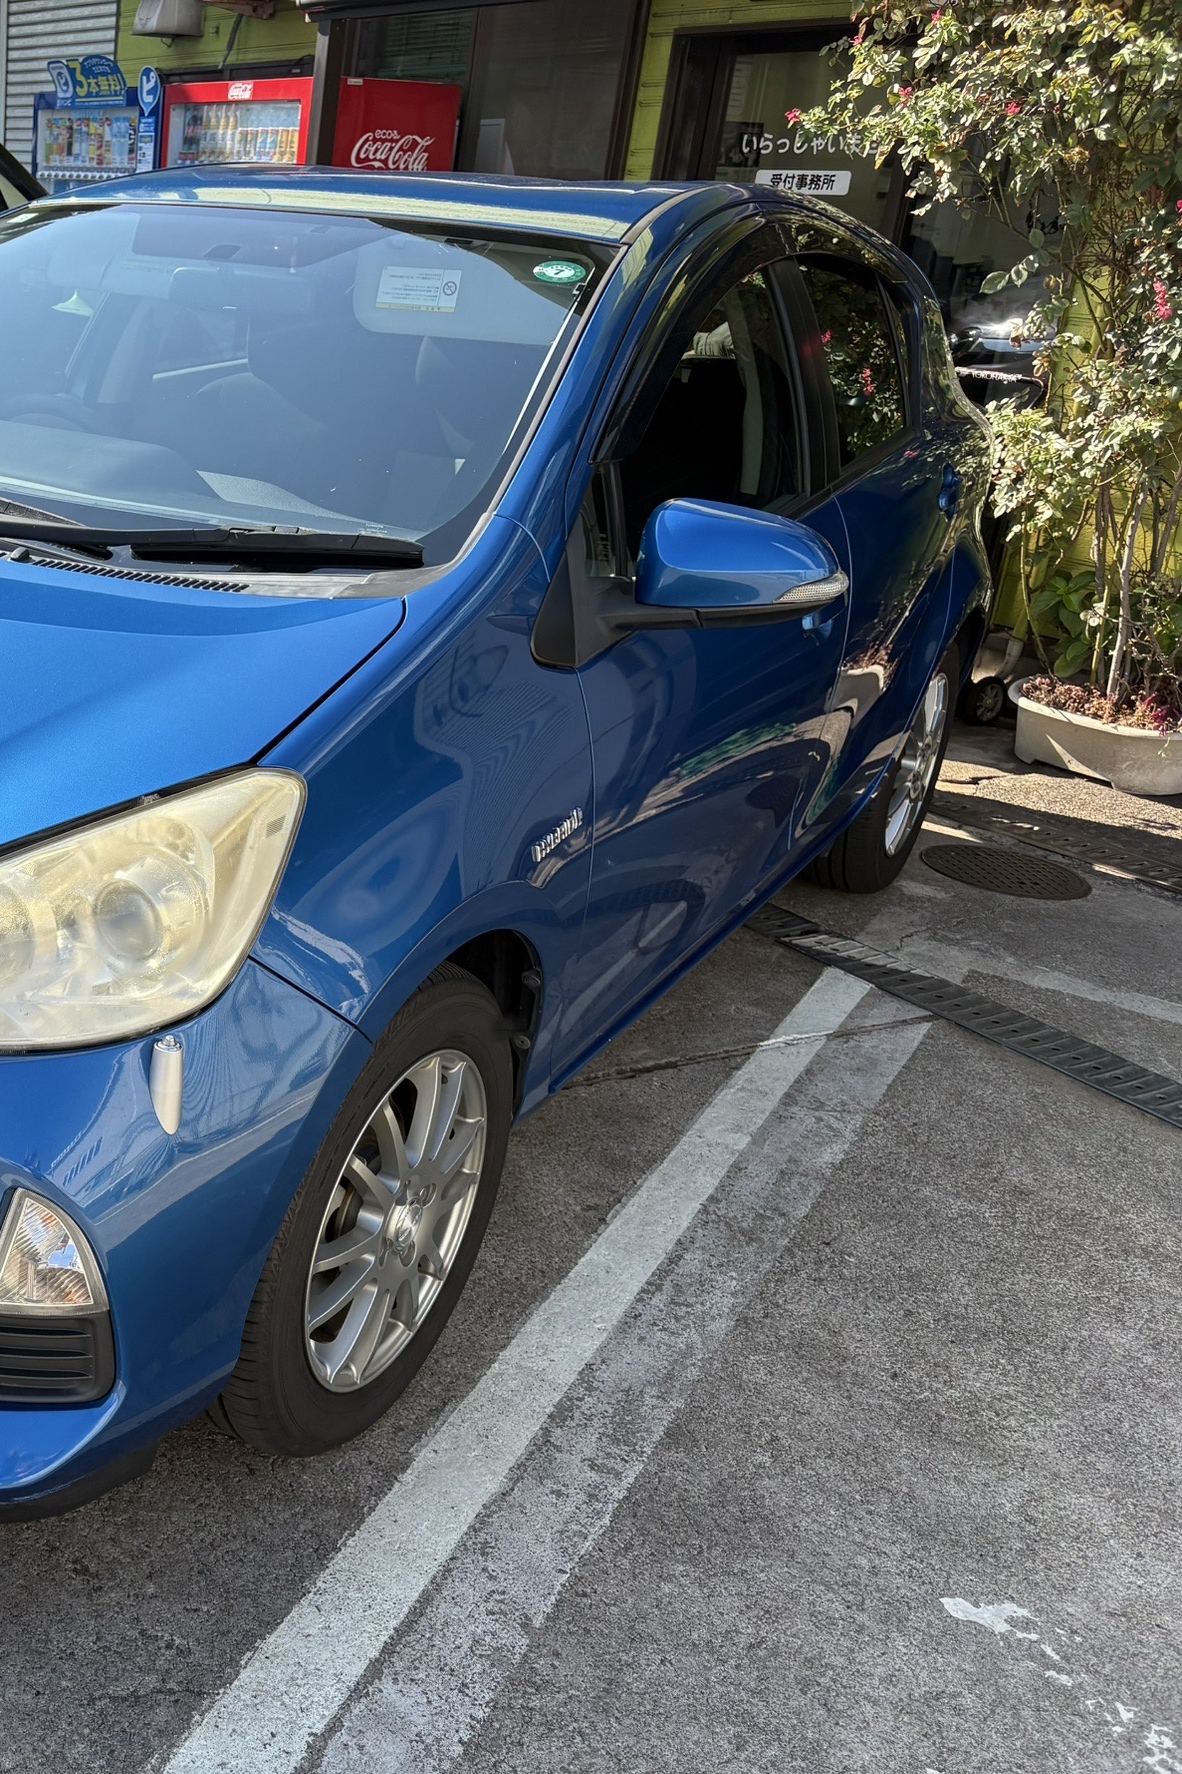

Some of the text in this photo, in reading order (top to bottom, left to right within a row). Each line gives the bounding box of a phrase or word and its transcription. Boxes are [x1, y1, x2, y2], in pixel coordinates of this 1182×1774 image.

[143, 71, 156, 103] ピ
[770, 173, 836, 191] 受付事務所
